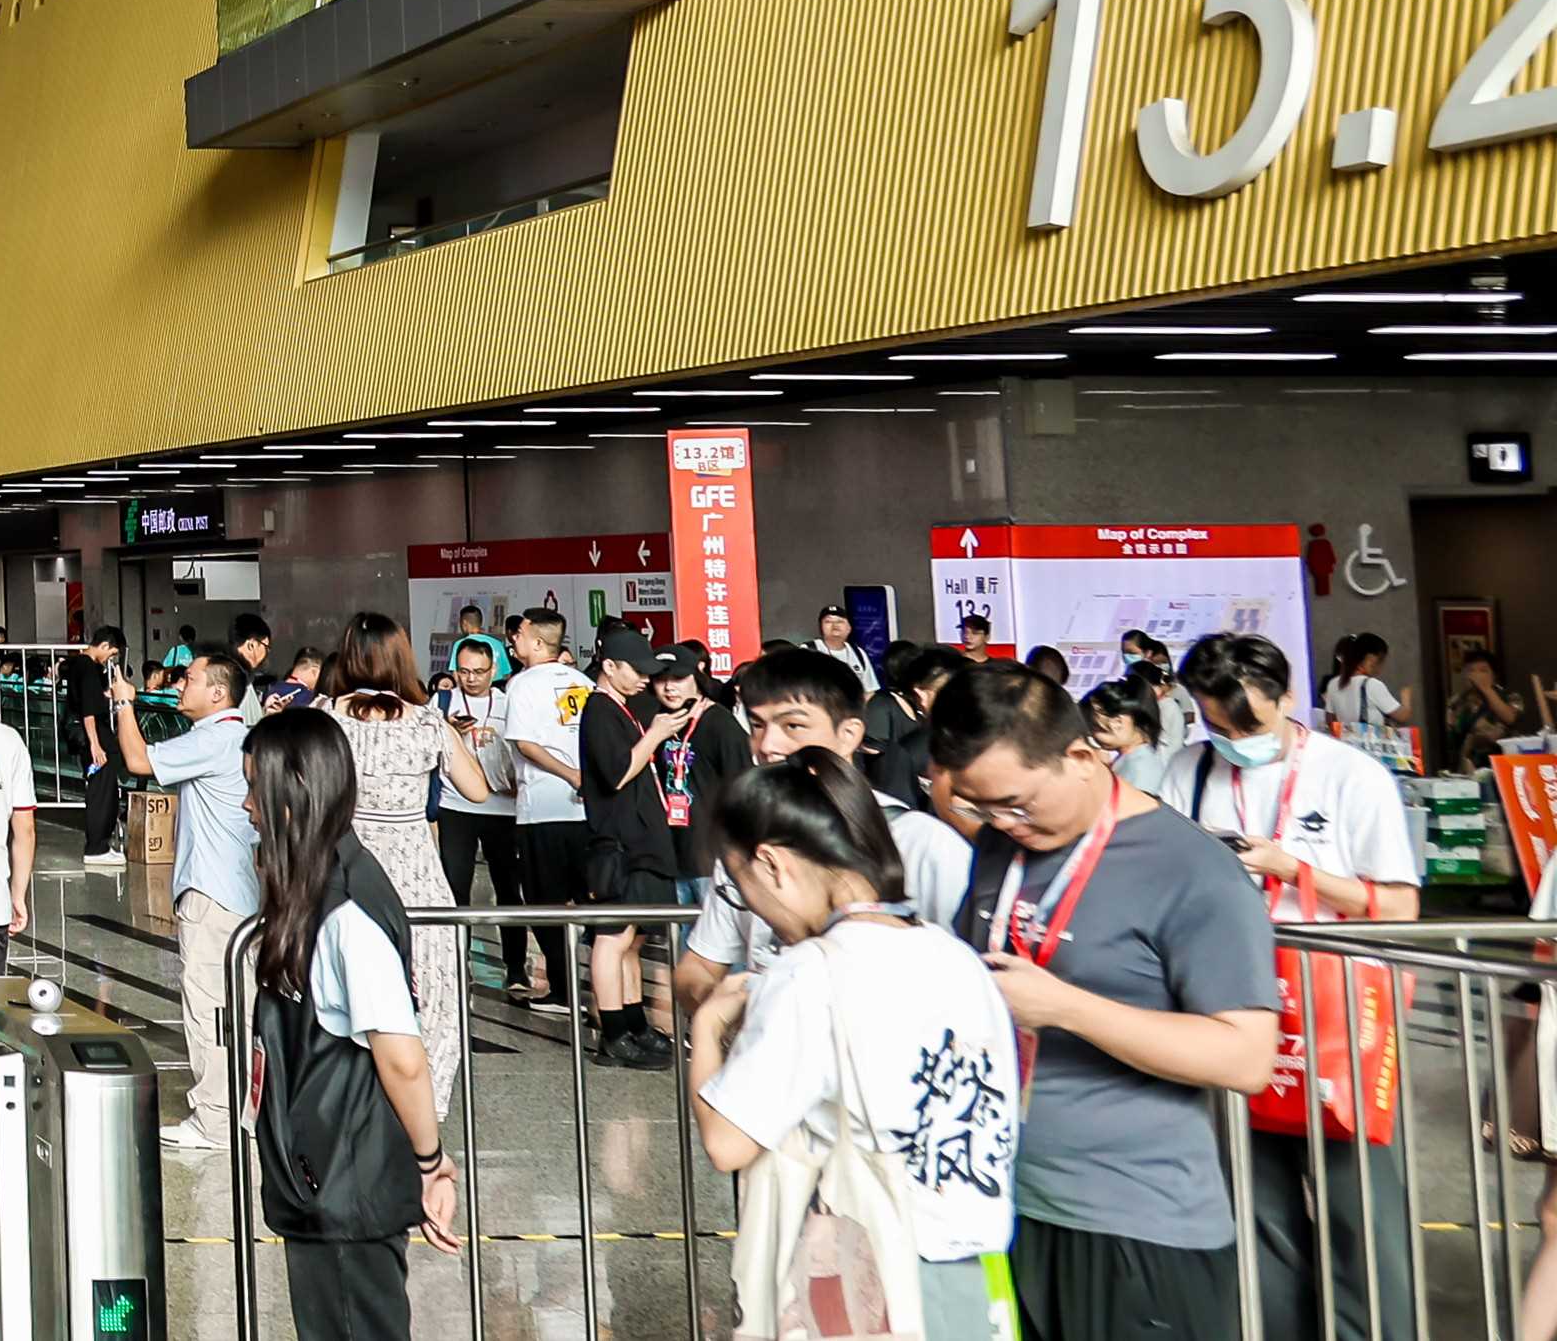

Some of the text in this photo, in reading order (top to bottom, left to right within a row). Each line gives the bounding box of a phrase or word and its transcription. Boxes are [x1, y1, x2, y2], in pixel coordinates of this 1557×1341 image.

[682, 445, 736, 460] 13.2馆
[697, 459, 719, 472] B区
[689, 484, 736, 508] GFE
[141, 507, 176, 535] 中国邮政
[195, 516, 209, 531] POST
[1097, 528, 1209, 542] Map of Complex
[440, 545, 488, 561] Map of Complex
[945, 576, 999, 595] Hall 展厅
[701, 512, 732, 684] 广州特许连锁加
[567, 694, 579, 716] 9
